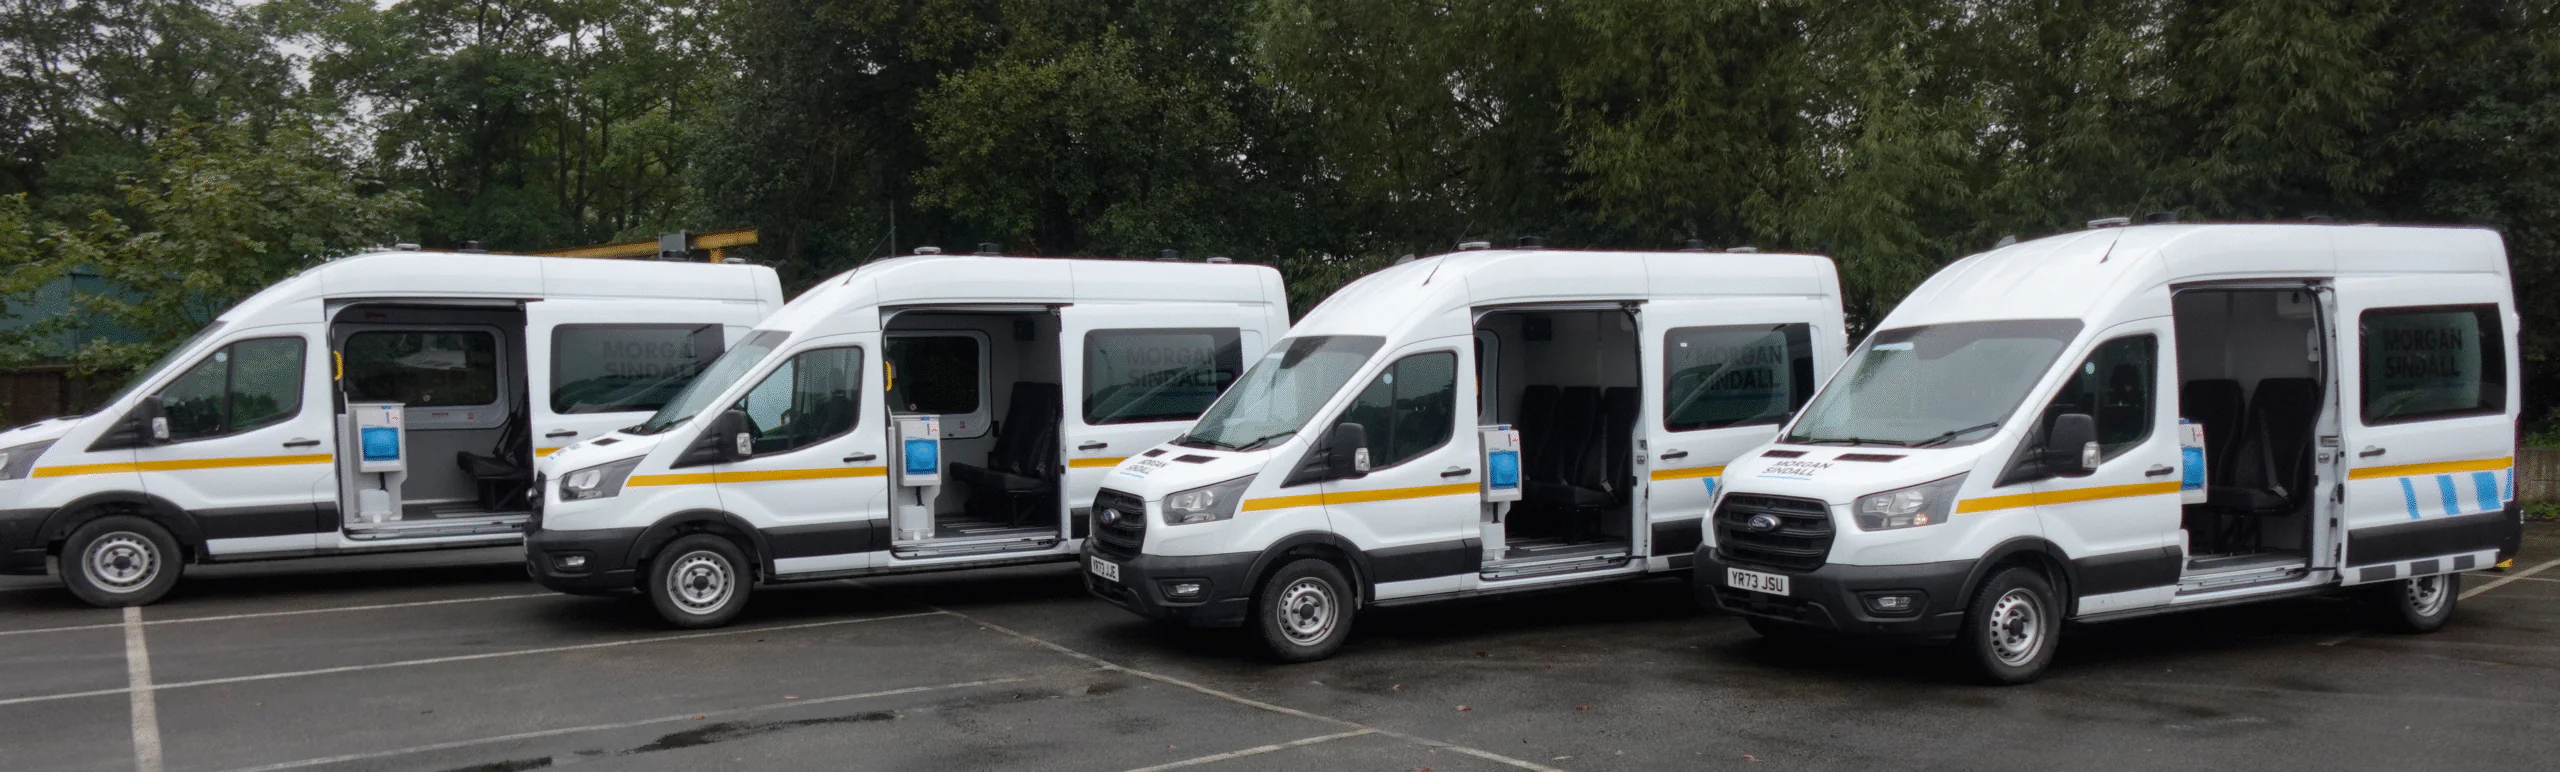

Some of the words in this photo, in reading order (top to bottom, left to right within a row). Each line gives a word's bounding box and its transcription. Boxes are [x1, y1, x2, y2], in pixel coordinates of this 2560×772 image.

[2382, 328, 2463, 351] MORGAN
[2384, 355, 2460, 378] SINDALL
[1762, 466, 1815, 476] SINDALL
[1772, 460, 1833, 469] MORGAN
[1731, 571, 1758, 588] YR73
[1762, 576, 1783, 592] JSU
